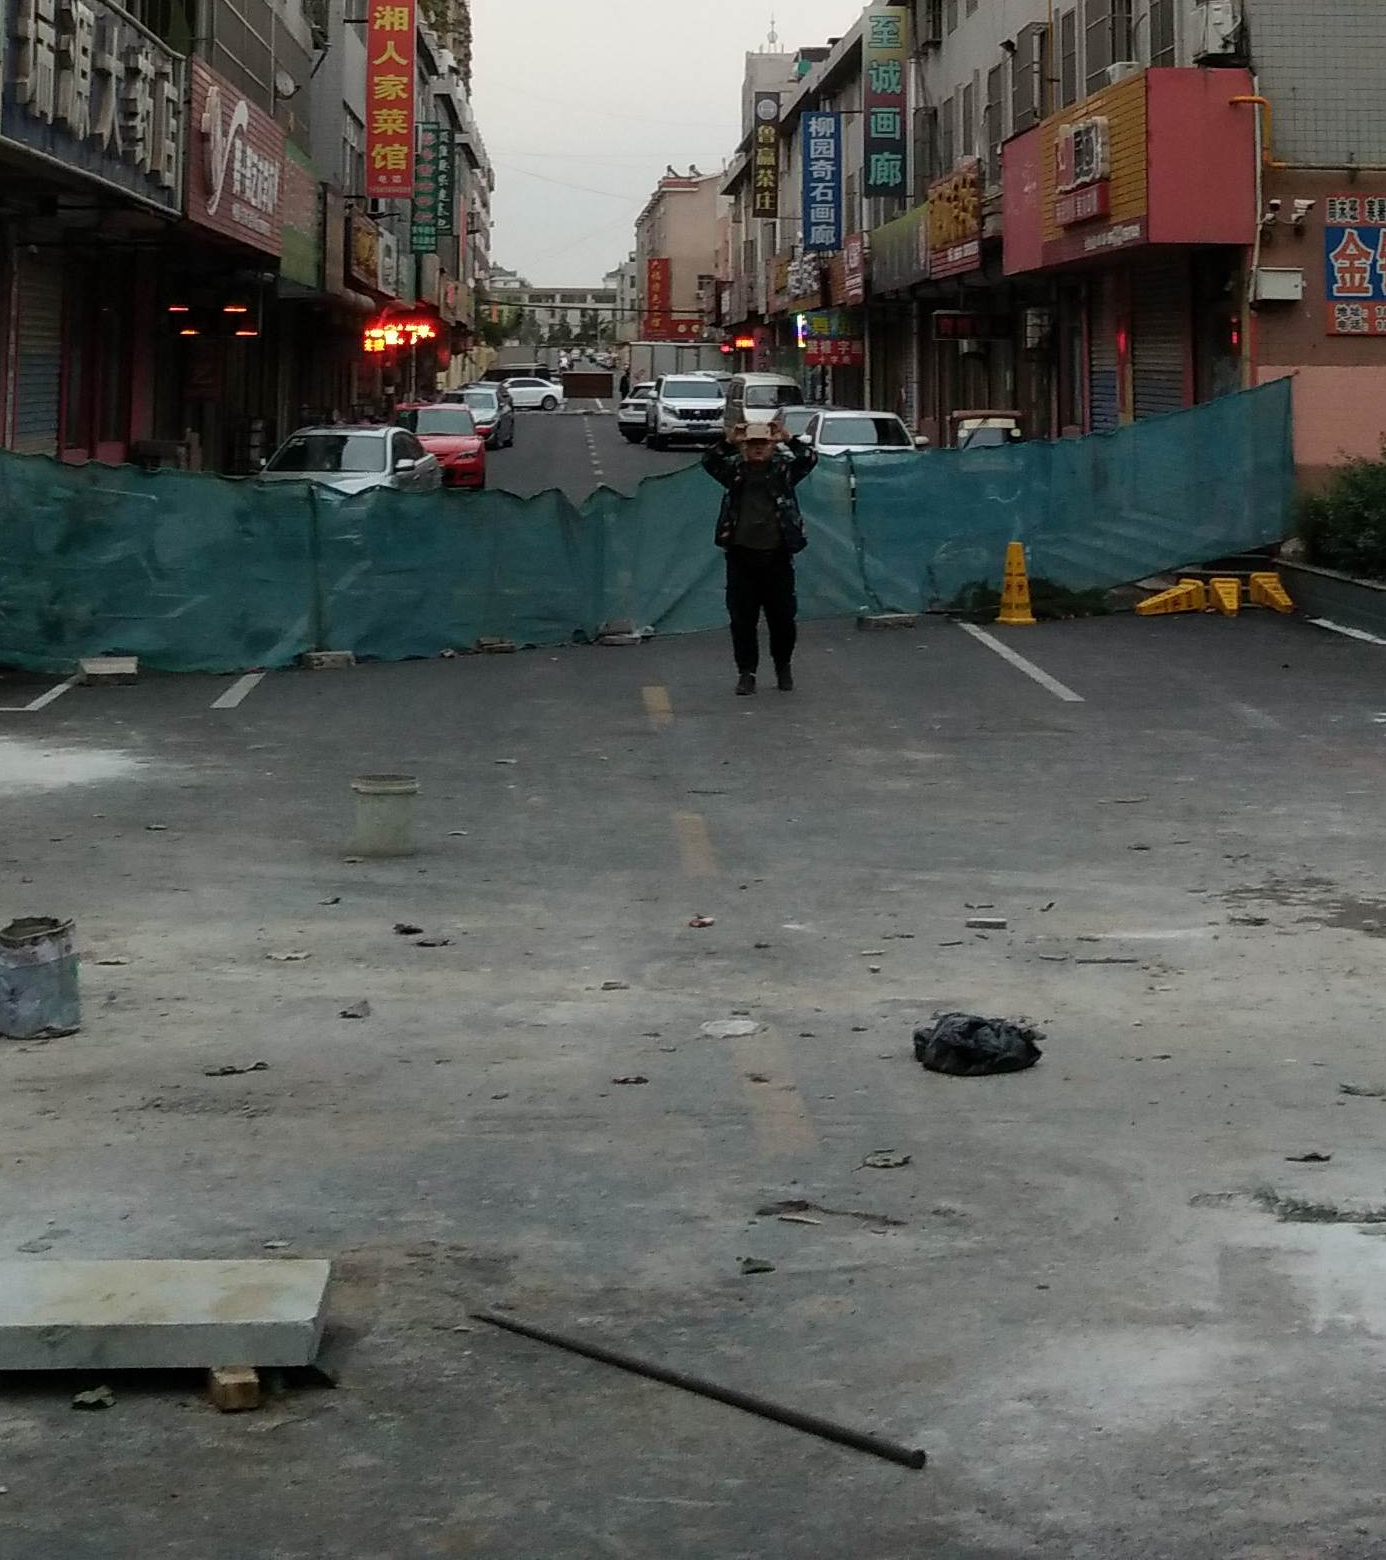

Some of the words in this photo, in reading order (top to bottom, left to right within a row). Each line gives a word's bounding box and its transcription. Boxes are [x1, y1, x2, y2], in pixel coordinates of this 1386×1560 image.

[868, 15, 904, 189] 至诚画廊
[808, 116, 836, 246] 柳园奇石画廊
